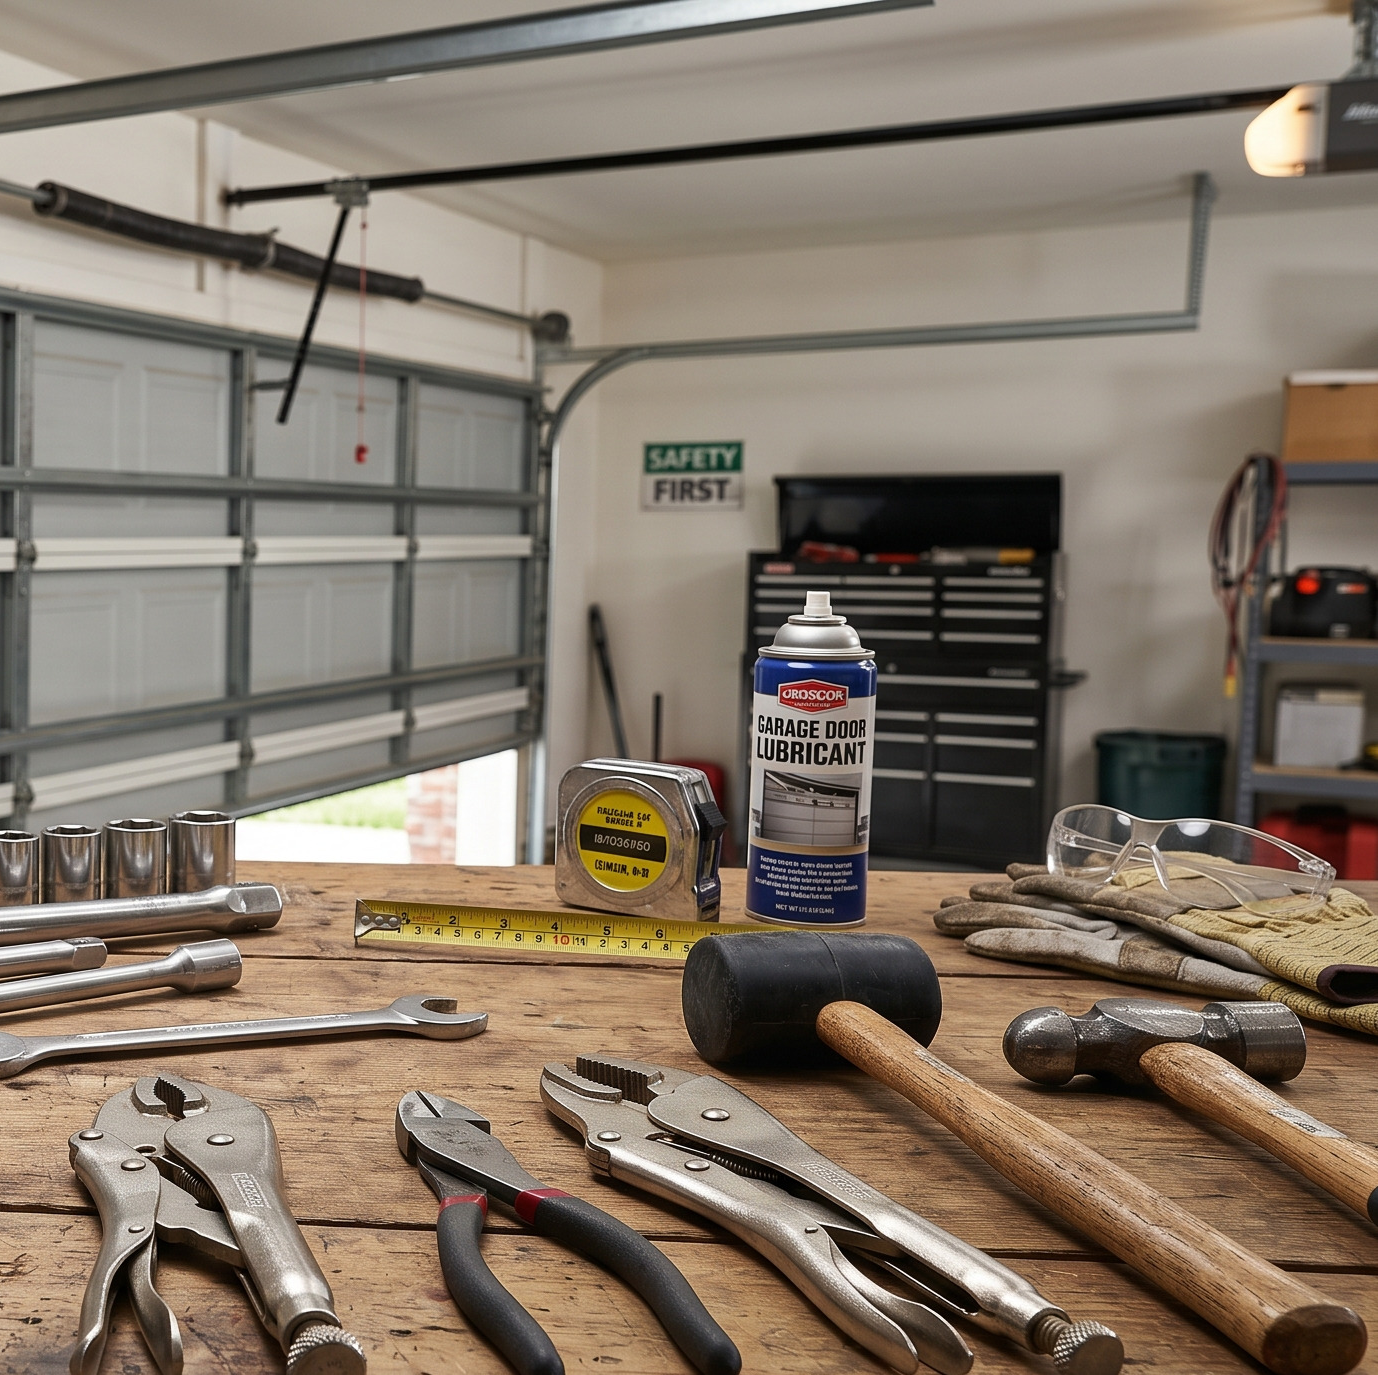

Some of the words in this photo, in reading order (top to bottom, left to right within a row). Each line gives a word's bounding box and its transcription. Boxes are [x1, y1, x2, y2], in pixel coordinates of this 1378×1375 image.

[648, 445, 739, 470] SAFETY
[653, 477, 732, 503] FIRST
[758, 715, 820, 739] GARAGE
[825, 719, 866, 739] DOOR
[757, 736, 866, 765] LUBRICANT
[414, 926, 421, 935] 3
[434, 927, 441, 936] 4
[454, 929, 461, 938] 5
[474, 930, 481, 939] 6
[494, 931, 501, 940] 7
[515, 933, 522, 942] 8
[535, 934, 543, 943] 9
[552, 935, 570, 945] 10
[599, 939, 607, 948] 2
[641, 941, 649, 950] 4
[448, 915, 456, 925] 2
[499, 918, 508, 928] 3
[550, 921, 559, 932] 4
[603, 925, 611, 936] 5
[655, 929, 664, 939] 6
